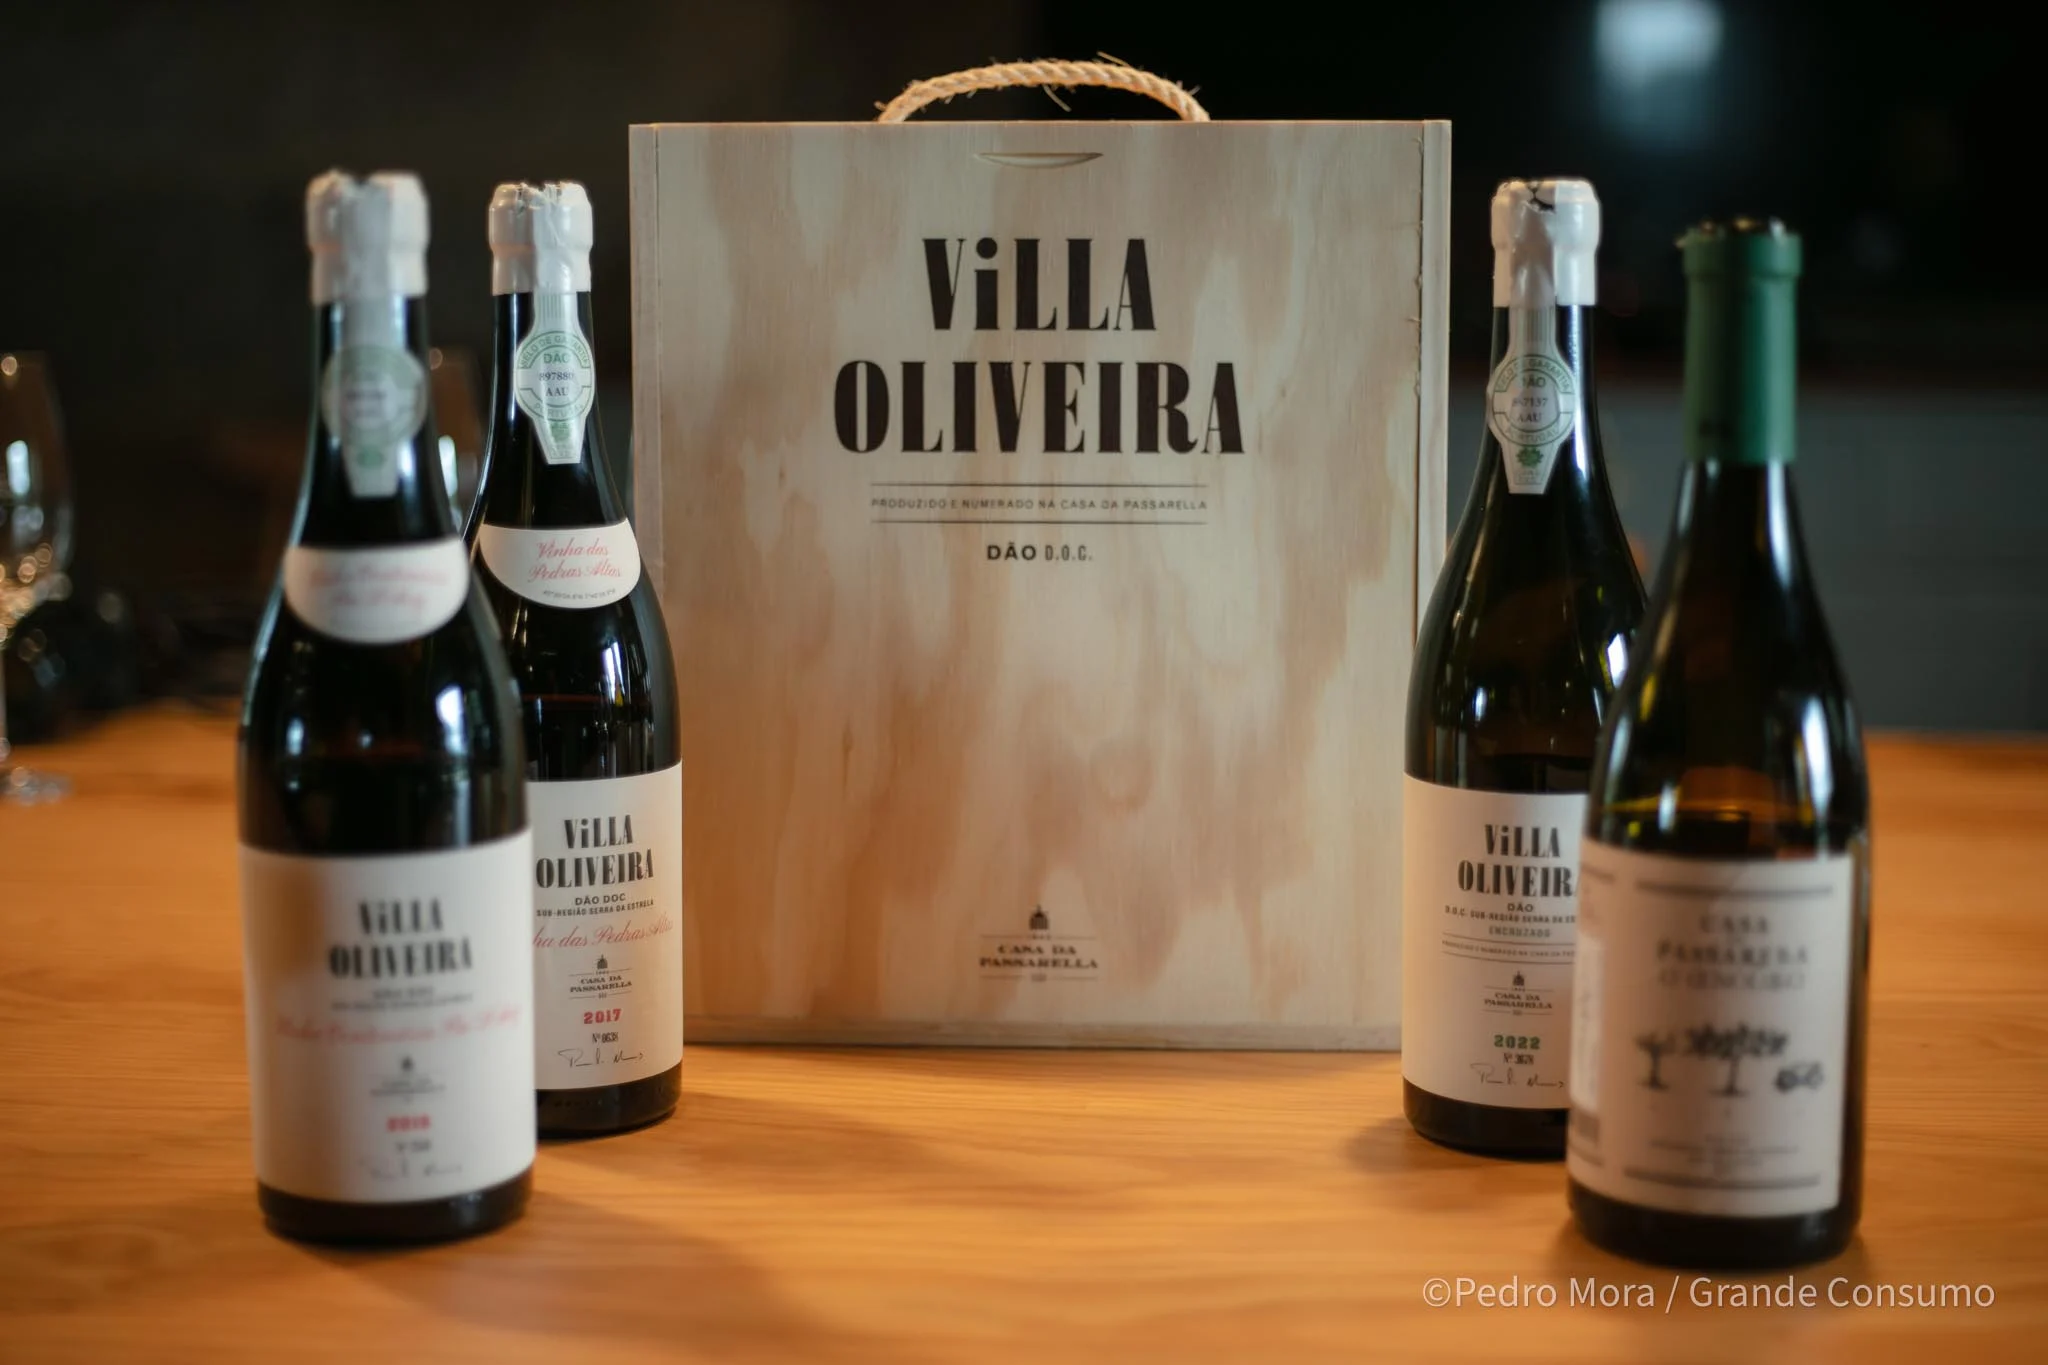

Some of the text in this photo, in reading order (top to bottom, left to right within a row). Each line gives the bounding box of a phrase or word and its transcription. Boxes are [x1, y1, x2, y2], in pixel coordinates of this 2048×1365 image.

[833, 360, 1245, 454] OLIVEIRA
[871, 498, 1208, 511] PRODUZIDO E NUMERADO NA CASA DA PASSARELLA
[536, 536, 609, 559] Vinha das
[987, 542, 1037, 561] DÃO
[528, 560, 582, 583] Pedras
[535, 848, 654, 889] OLIVEIRA
[575, 892, 626, 906] DÃO DOC
[1507, 902, 1534, 912] DÃO
[536, 899, 654, 917] SUB-REGIÃO SERRA DA ESTRELA
[1488, 925, 1551, 938] ENCRUZADO
[583, 1008, 621, 1024] 2017
[1494, 1034, 1541, 1050] 2022
